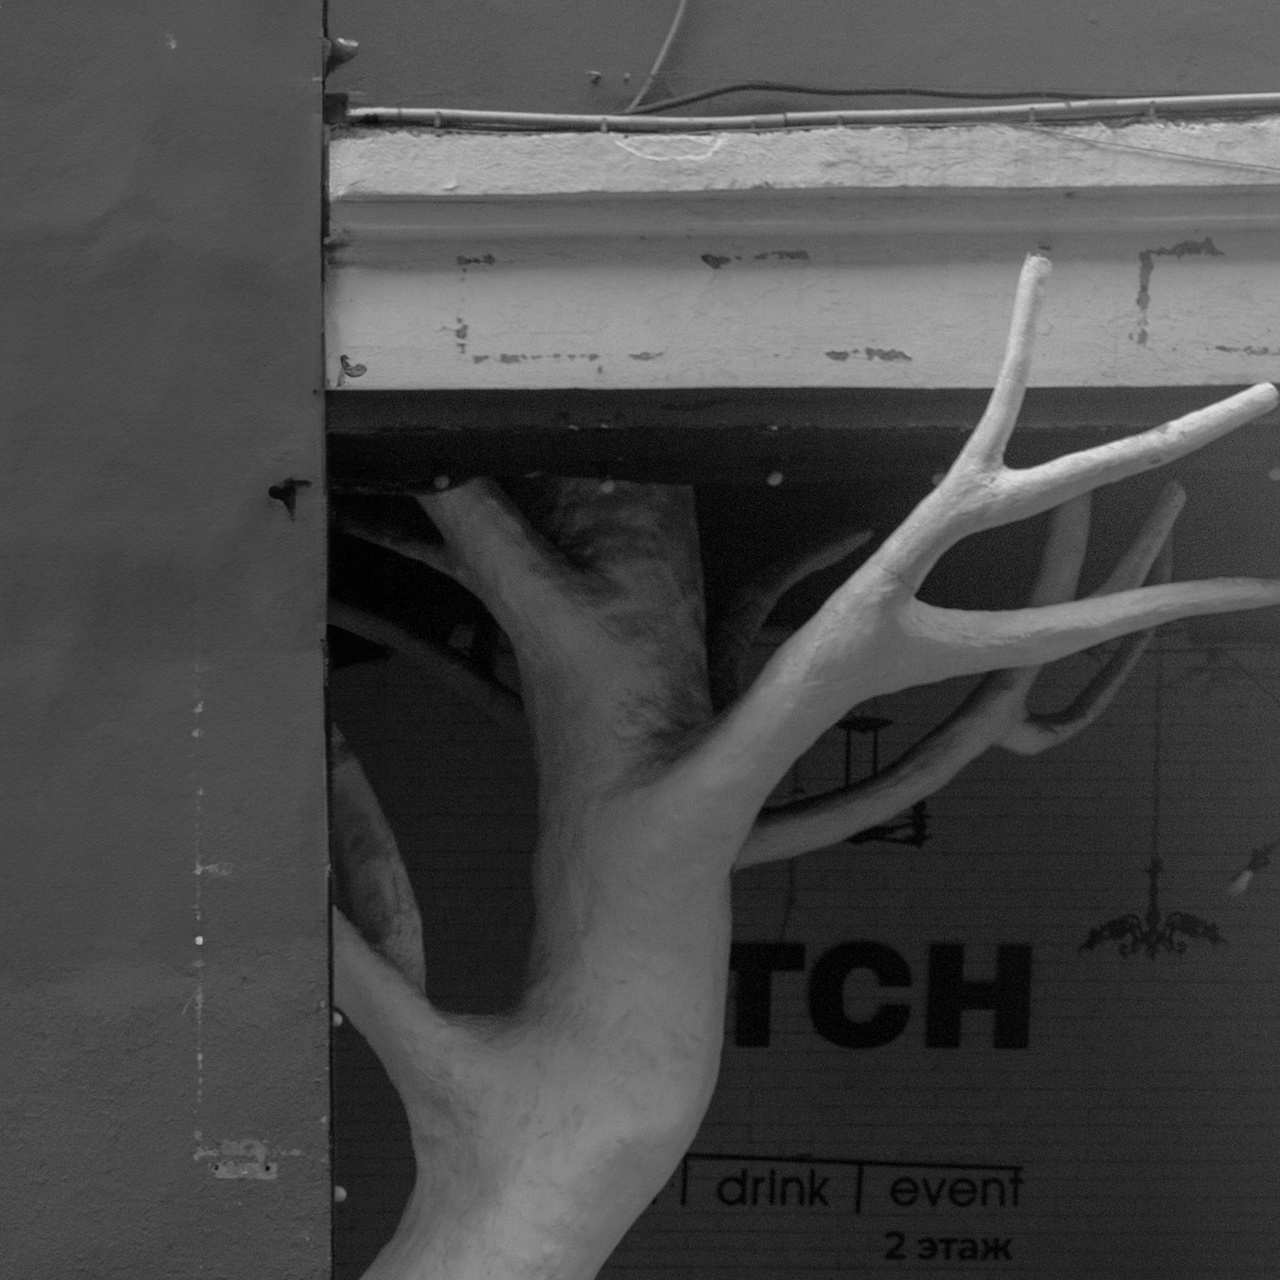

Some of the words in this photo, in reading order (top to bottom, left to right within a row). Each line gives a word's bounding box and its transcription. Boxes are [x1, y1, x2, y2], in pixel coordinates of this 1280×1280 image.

[717, 1169, 830, 1207] drink
[889, 1168, 1024, 1208] event
[884, 1231, 907, 1261] 2
[917, 1236, 1013, 1261] этаж
